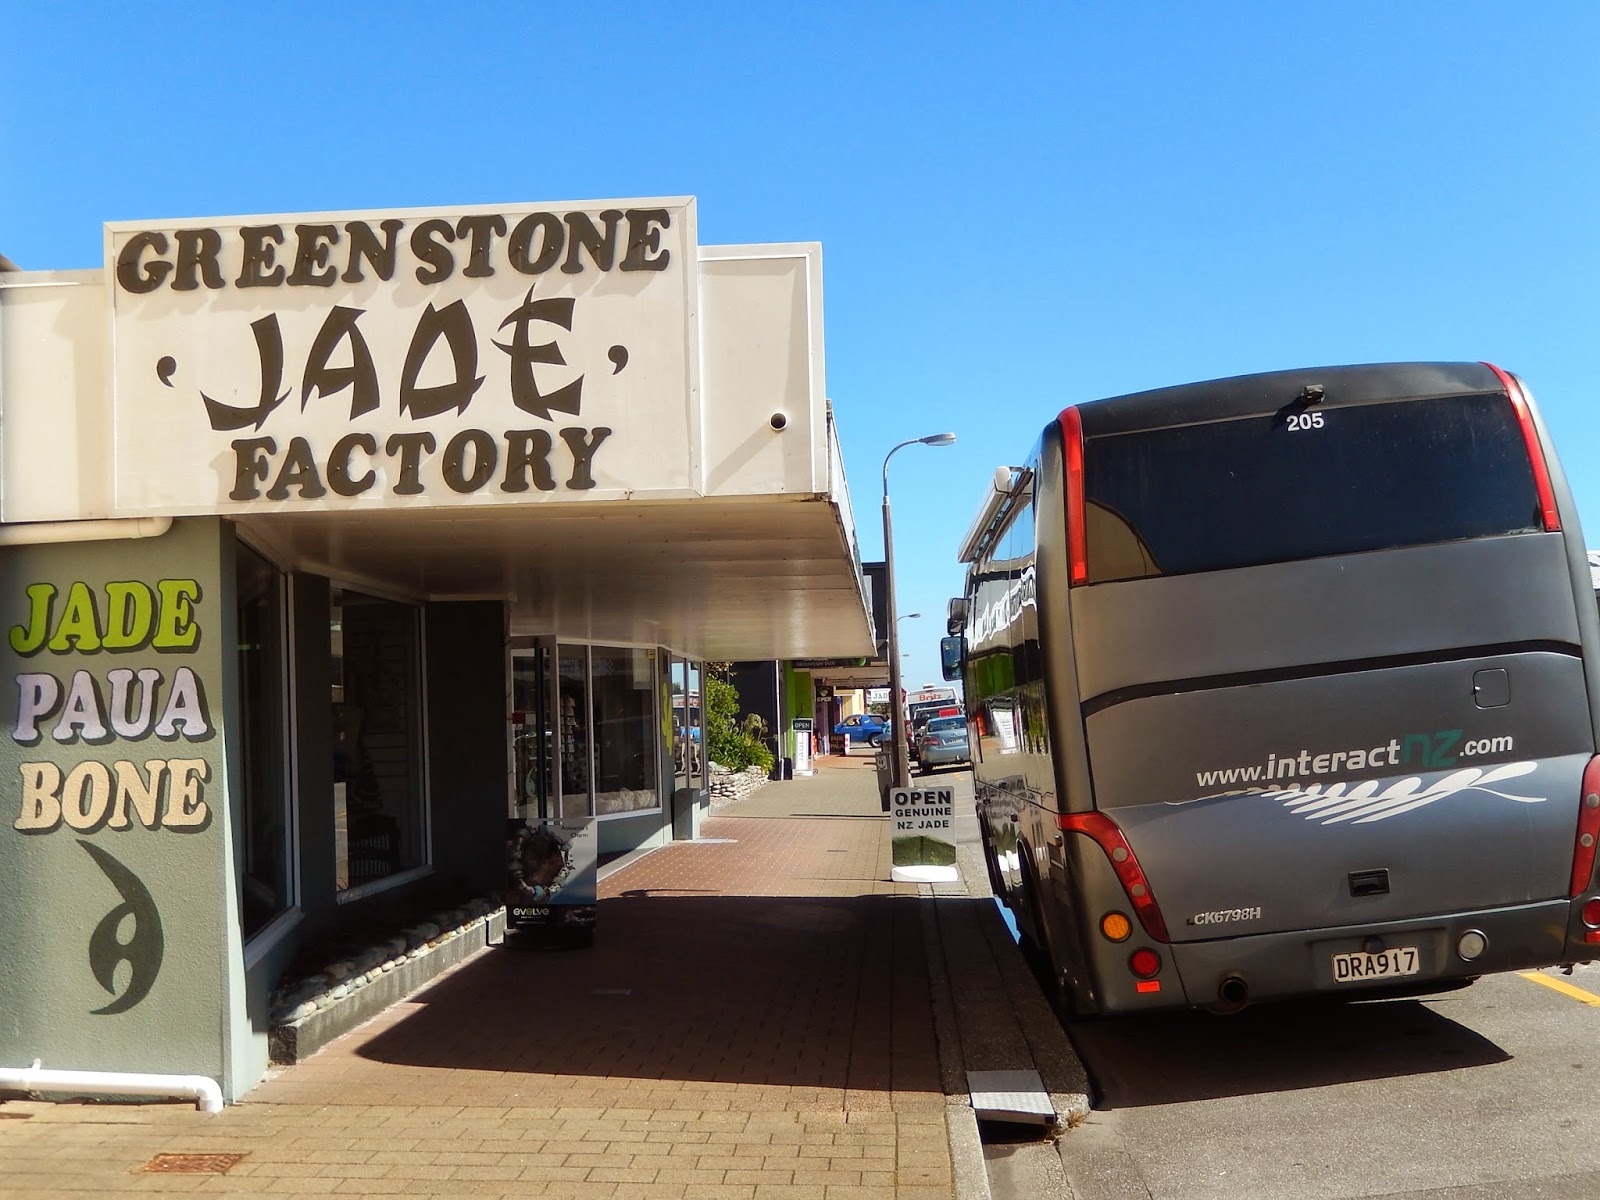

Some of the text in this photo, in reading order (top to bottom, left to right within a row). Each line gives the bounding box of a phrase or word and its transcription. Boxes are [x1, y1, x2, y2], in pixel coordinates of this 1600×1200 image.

[116, 208, 670, 294] GREENSTONE
[200, 282, 585, 432] JADE
[1286, 412, 1324, 431] 205
[228, 426, 612, 501] FACTORY
[9, 578, 202, 658] JADE
[12, 666, 216, 747] PAUA
[919, 693, 942, 701] Britz
[14, 758, 212, 835] BONE
[895, 791, 951, 806] OPEN
[895, 807, 951, 817] GENUINE
[897, 820, 949, 829] NZ JADE
[1336, 951, 1416, 979] DRA917
